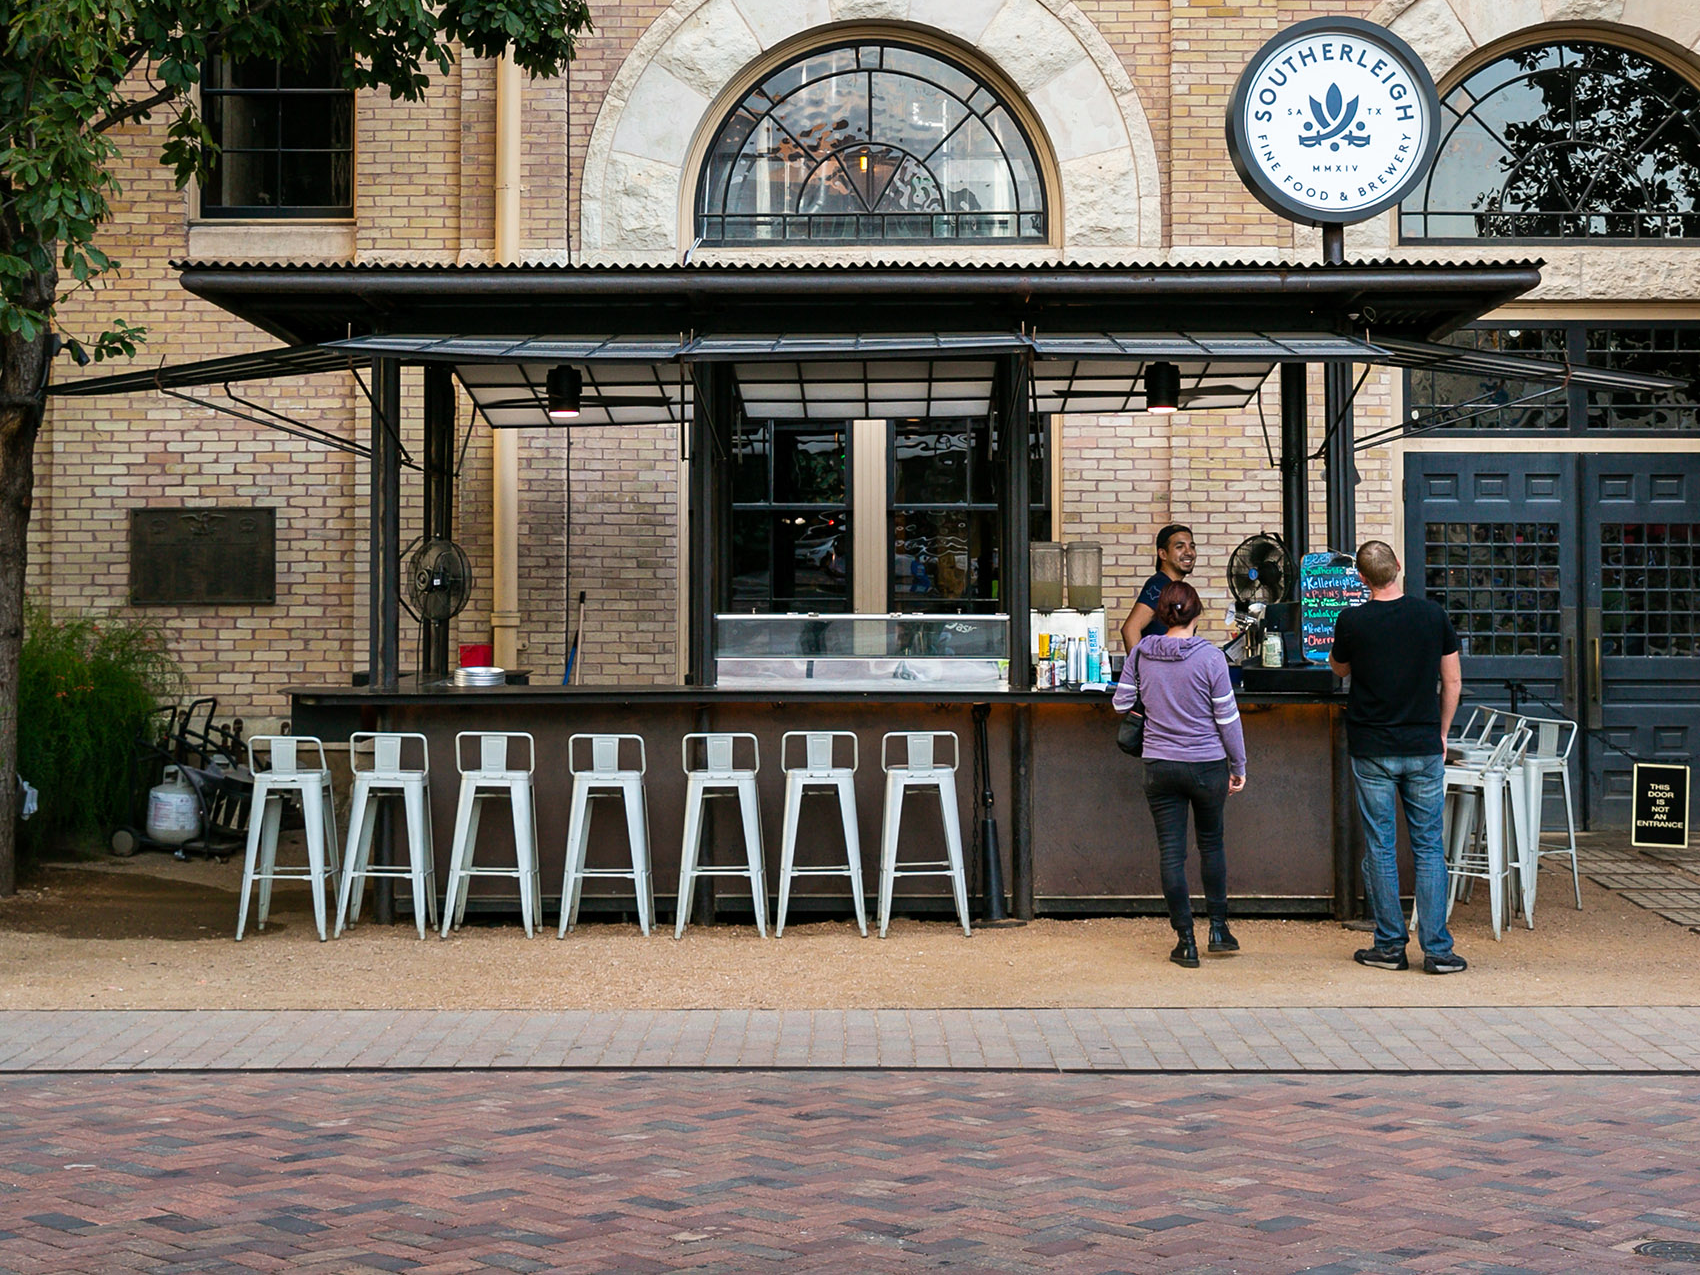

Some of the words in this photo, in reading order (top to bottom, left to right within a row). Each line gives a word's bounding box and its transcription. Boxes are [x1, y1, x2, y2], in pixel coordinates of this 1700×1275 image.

[1255, 43, 1414, 122] SOUTHERLEIGH
[1287, 108, 1302, 116] SA
[1367, 108, 1382, 116] TX
[1257, 134, 1281, 172] FINE
[1284, 175, 1329, 201] FOOD
[1340, 192, 1348, 201] &
[1358, 133, 1412, 197] BREWERY
[1313, 165, 1359, 173] MMXIV
[1650, 783, 1670, 791] THIS
[1637, 820, 1683, 829] ENTRANCE
